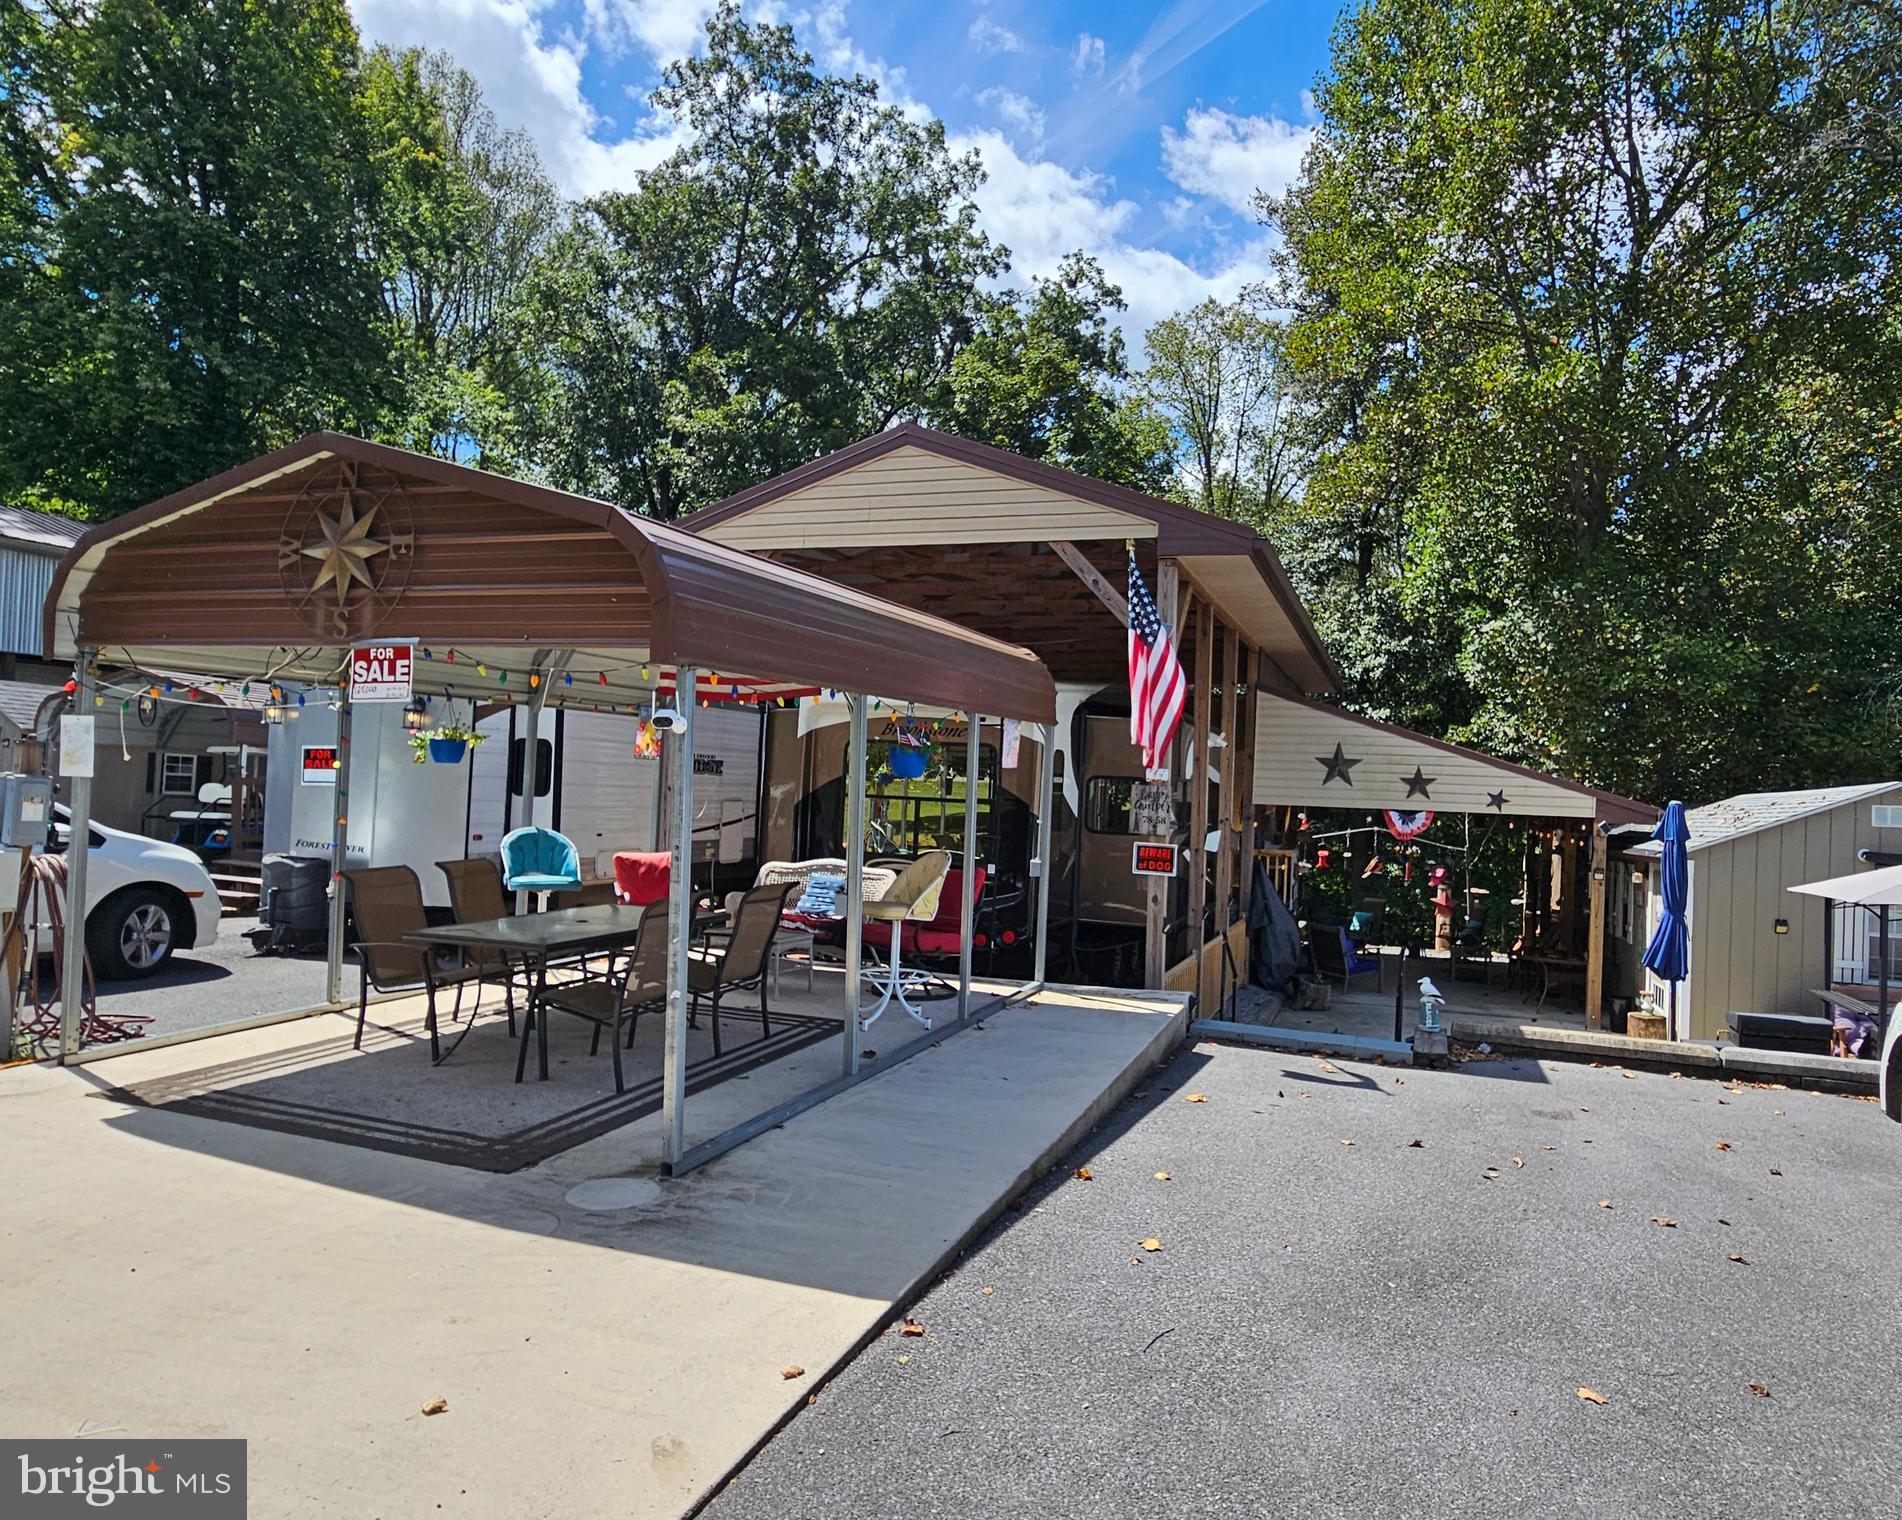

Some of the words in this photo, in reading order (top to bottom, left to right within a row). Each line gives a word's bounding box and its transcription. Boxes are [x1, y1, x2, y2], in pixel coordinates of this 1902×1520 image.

[333, 608, 349, 639] S
[370, 647, 394, 660] FOR
[354, 659, 410, 683] SALE
[310, 750, 331, 759] FOR
[1139, 847, 1172, 859] BEWARE
[1138, 861, 1148, 869] of
[1148, 861, 1172, 872] DOG
